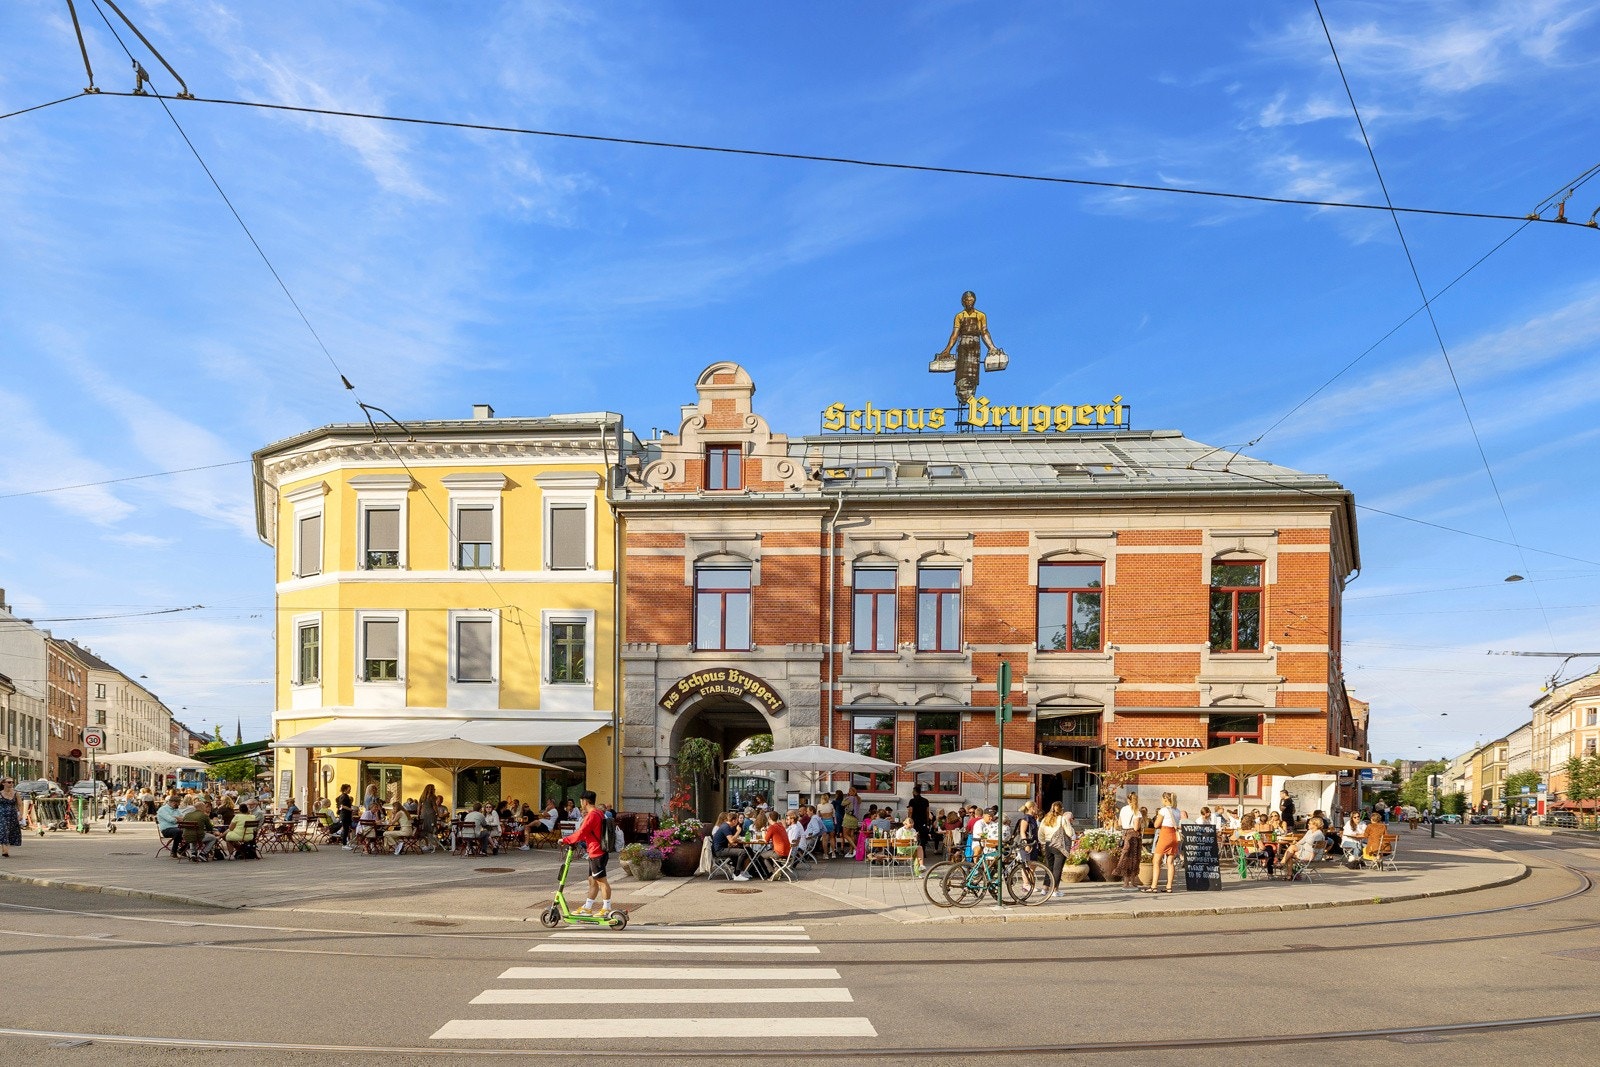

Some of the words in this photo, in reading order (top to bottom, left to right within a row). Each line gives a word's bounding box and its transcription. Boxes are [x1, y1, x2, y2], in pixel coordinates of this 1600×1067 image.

[822, 401, 946, 435] Schous
[966, 394, 1124, 433] Bryggeri
[678, 671, 726, 693] Schous
[727, 669, 783, 710] Bryggeri
[1115, 737, 1202, 748] TRATTORIA
[1115, 750, 1194, 761] POPOLAR
